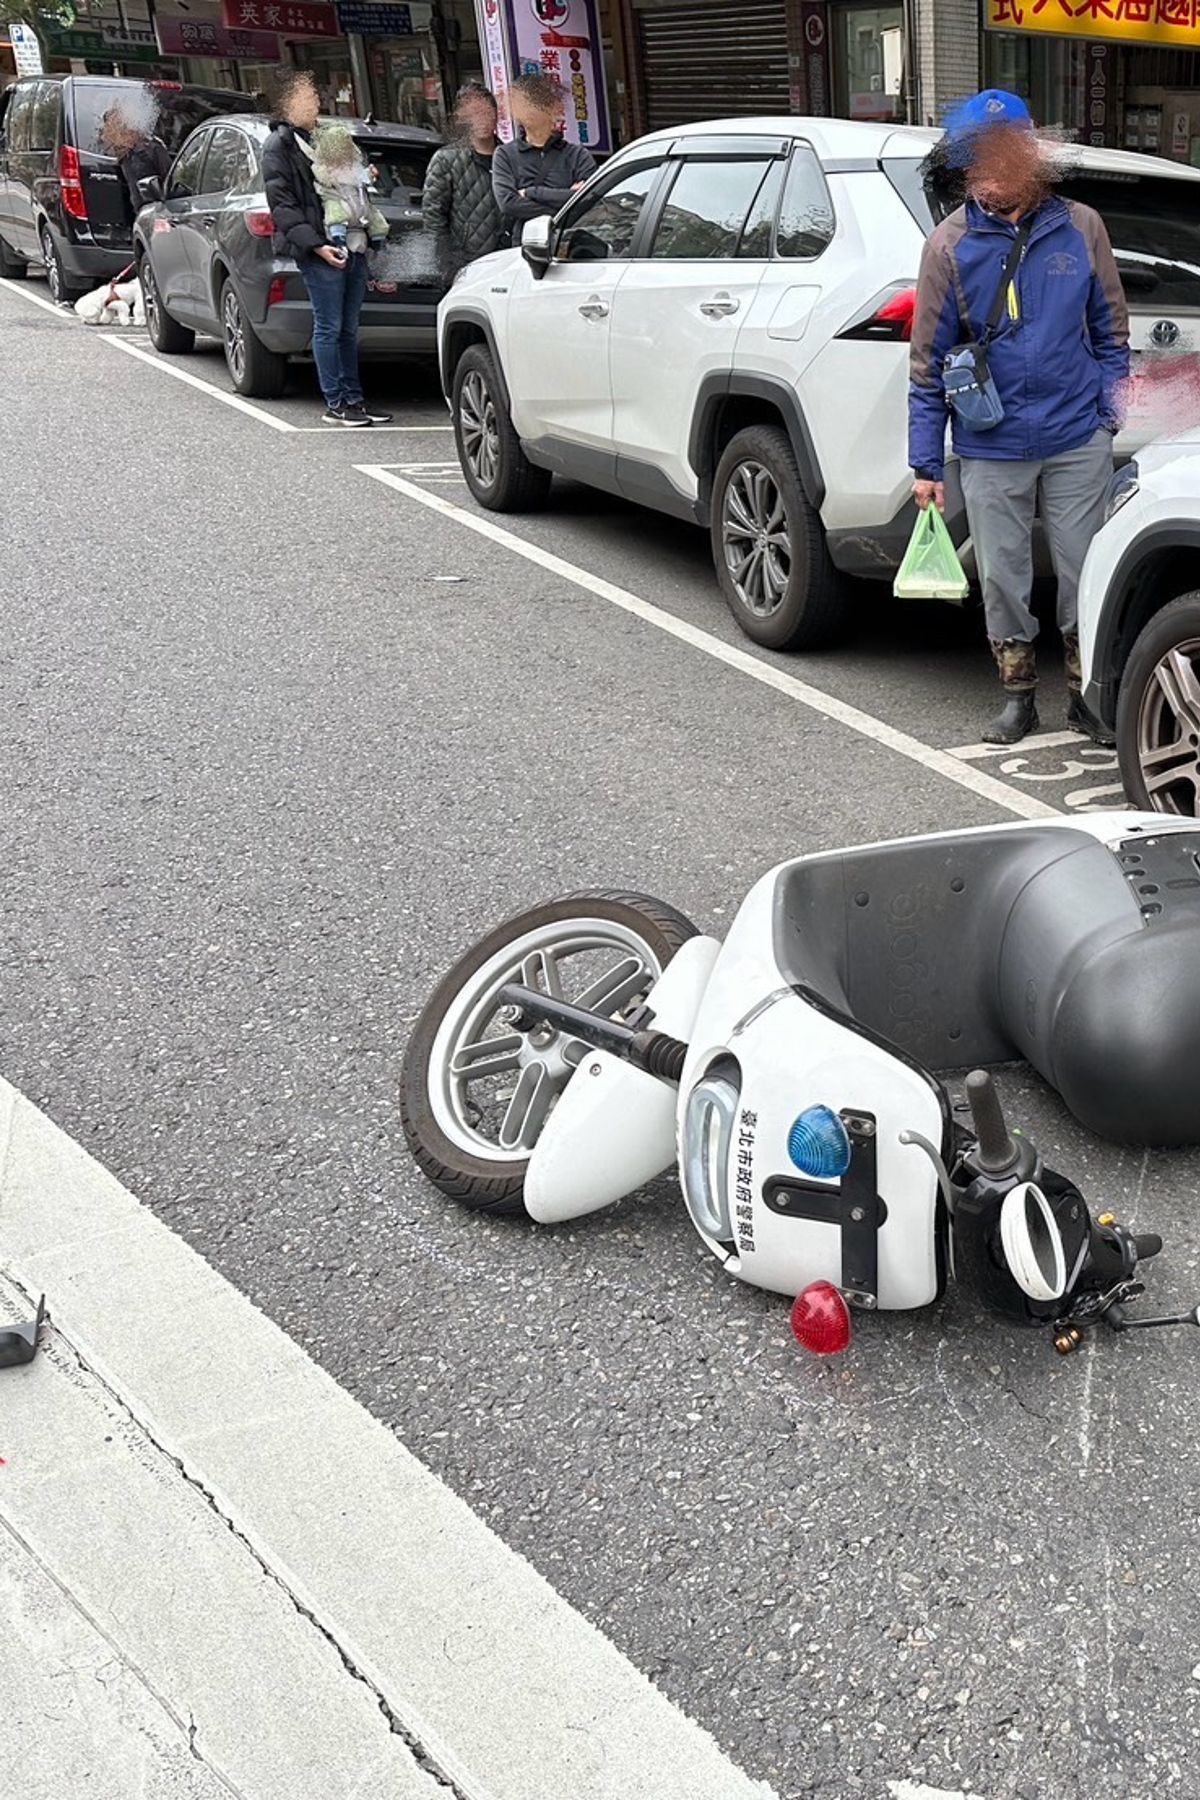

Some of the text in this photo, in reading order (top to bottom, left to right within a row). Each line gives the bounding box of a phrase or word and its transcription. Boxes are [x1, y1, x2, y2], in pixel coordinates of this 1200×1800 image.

[239, 2, 284, 26] 英家
[735, 1108, 758, 1252] 臺北市政府警察局
